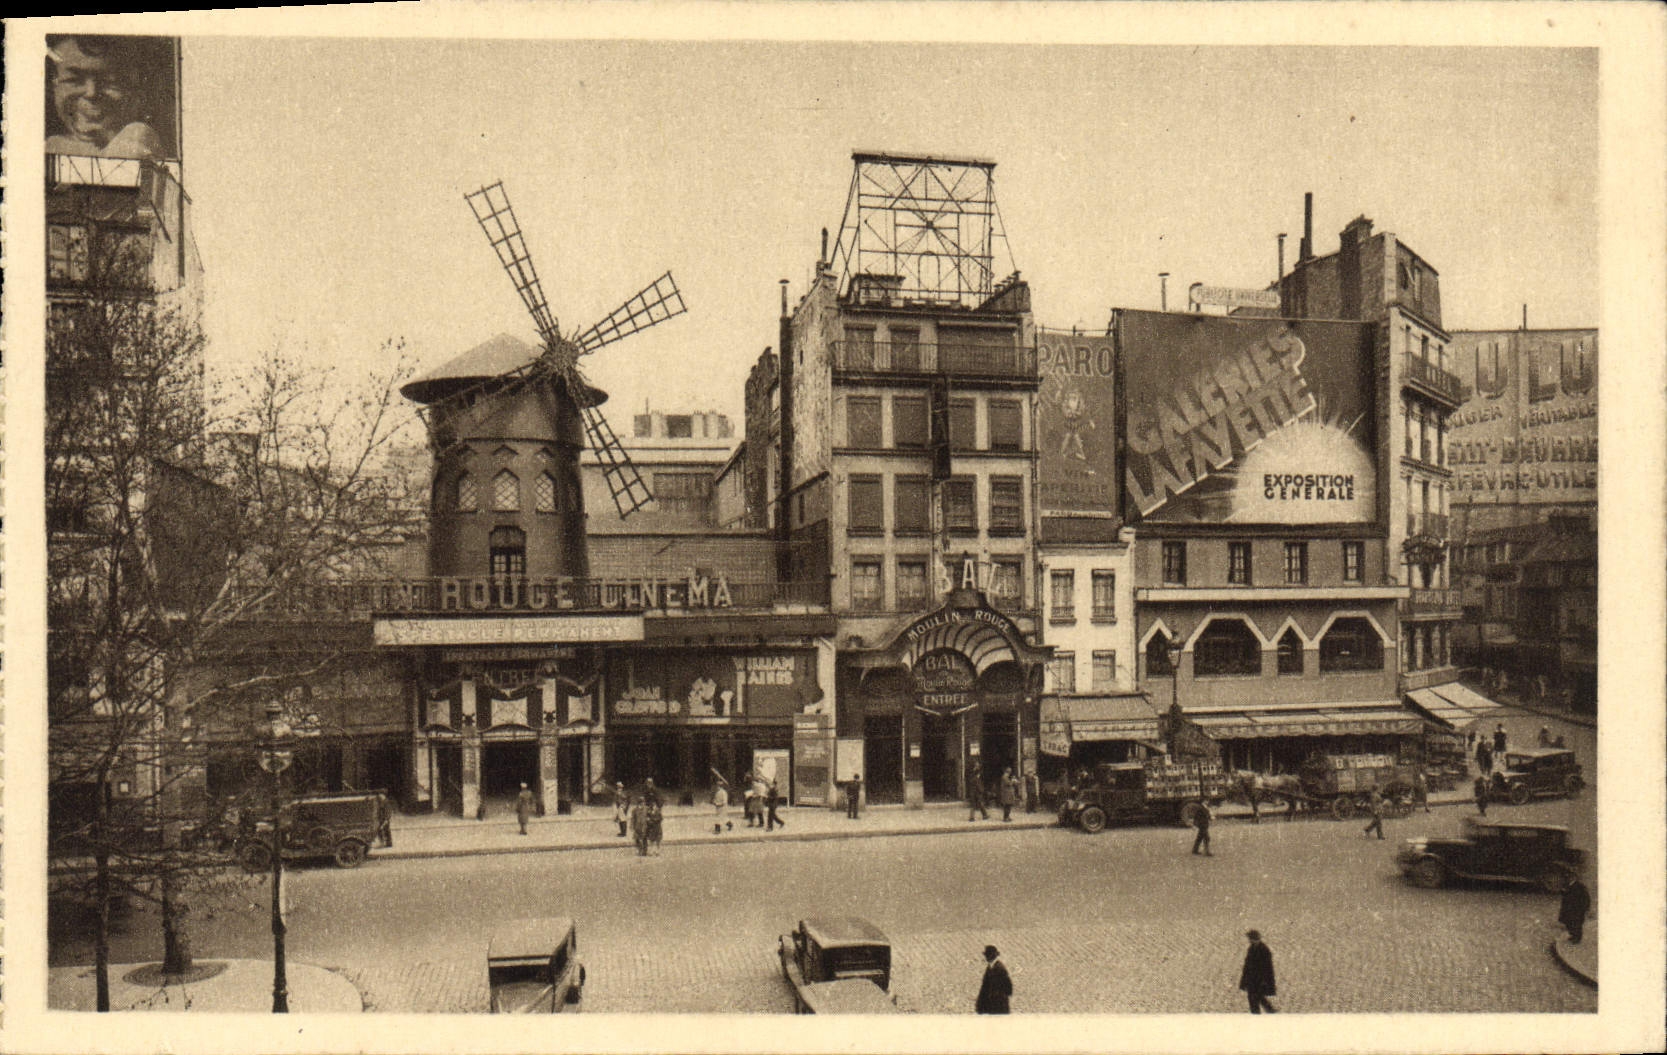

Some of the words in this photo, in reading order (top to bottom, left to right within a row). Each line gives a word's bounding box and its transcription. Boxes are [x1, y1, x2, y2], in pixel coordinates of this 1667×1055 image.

[1126, 374, 1317, 517] LAFAYETTE
[1263, 473, 1355, 488] EXPOSITION
[1263, 486, 1355, 500] GENERALE
[439, 577, 575, 611] ROUGE
[514, 626, 622, 640] PERMANENT
[906, 611, 961, 642] MOULIN
[974, 609, 1011, 634] ROUGE
[926, 652, 962, 671] BAL
